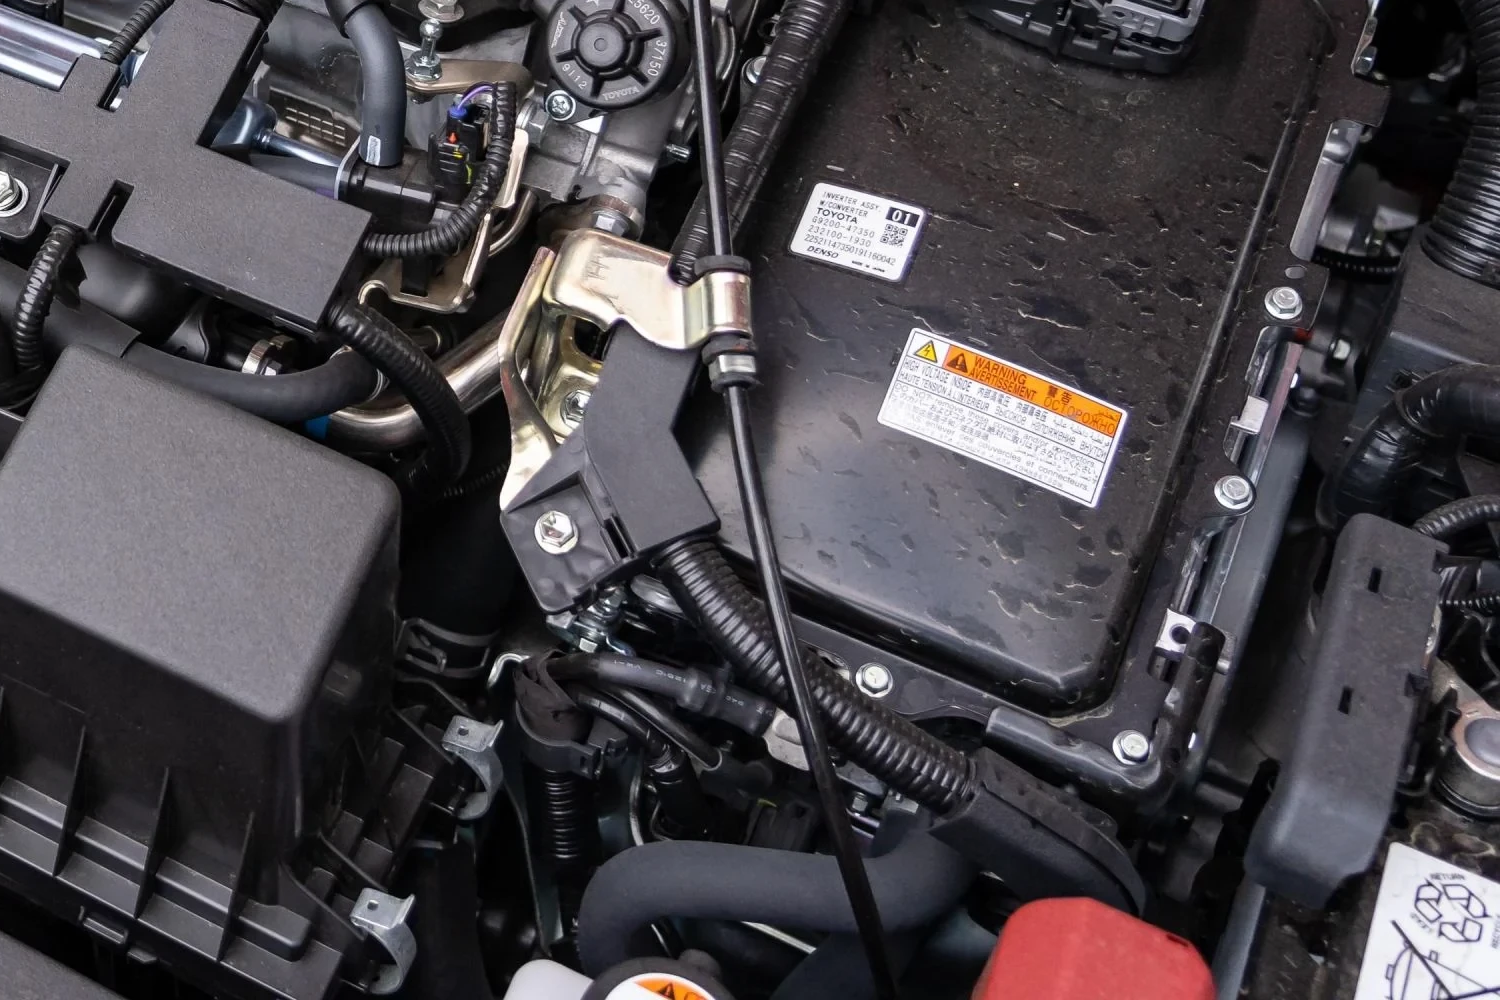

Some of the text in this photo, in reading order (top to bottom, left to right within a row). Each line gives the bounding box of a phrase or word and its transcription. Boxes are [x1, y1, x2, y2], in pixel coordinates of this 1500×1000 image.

[646, 38, 668, 77] 37150
[602, 85, 640, 101] TOYOTA
[823, 191, 857, 205] INVERTER
[812, 215, 875, 237] G9200-47350
[816, 207, 859, 223] TOYOTA
[891, 209, 911, 224] 01
[808, 224, 871, 247] 232100-1930
[807, 245, 839, 258] DENSO
[899, 370, 919, 384] HAUTE
[921, 379, 946, 395] TENSION
[904, 358, 971, 392] HIGH VOLTAGE INSIDE
[974, 357, 1026, 385] WARNING
[969, 367, 1035, 401] AVERTISSEMENT
[1043, 397, 1115, 434] ОСТОРОЖНО
